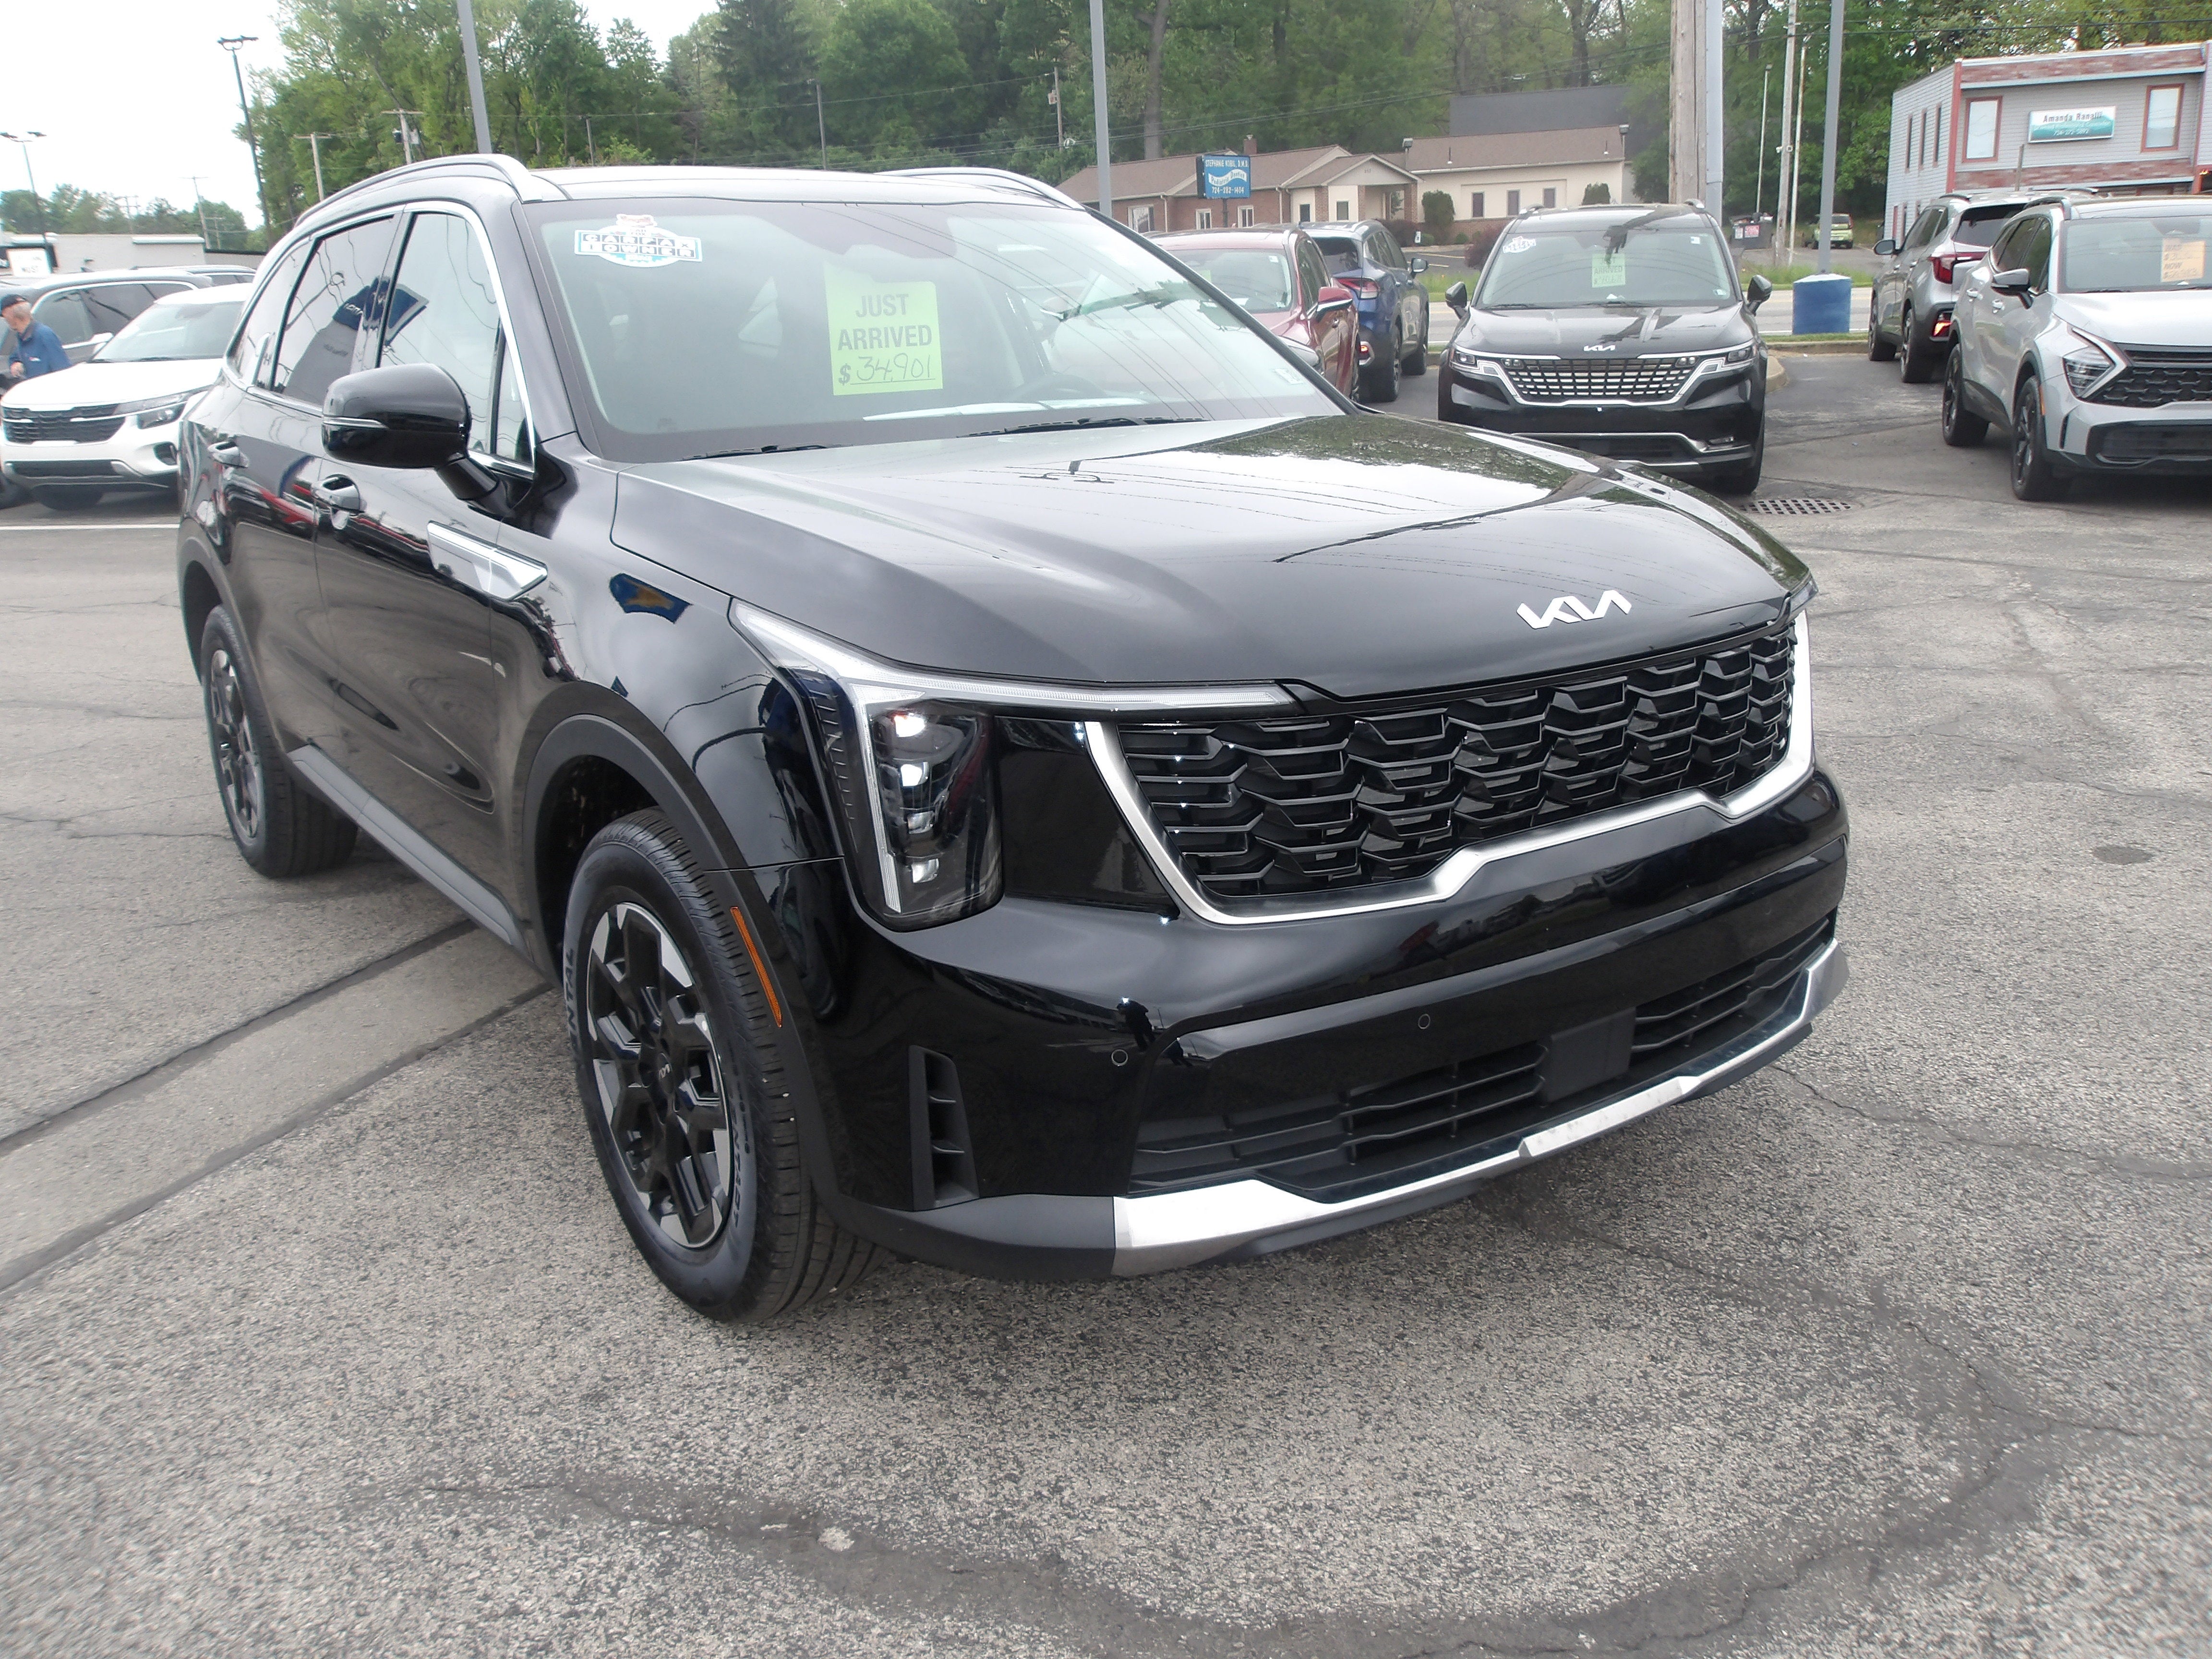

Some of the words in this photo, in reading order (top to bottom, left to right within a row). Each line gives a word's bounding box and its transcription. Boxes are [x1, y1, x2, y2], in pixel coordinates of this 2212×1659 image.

[2043, 114, 2073, 123] Amanda
[855, 294, 909, 318] JUST
[838, 325, 932, 350] ARRIVED
